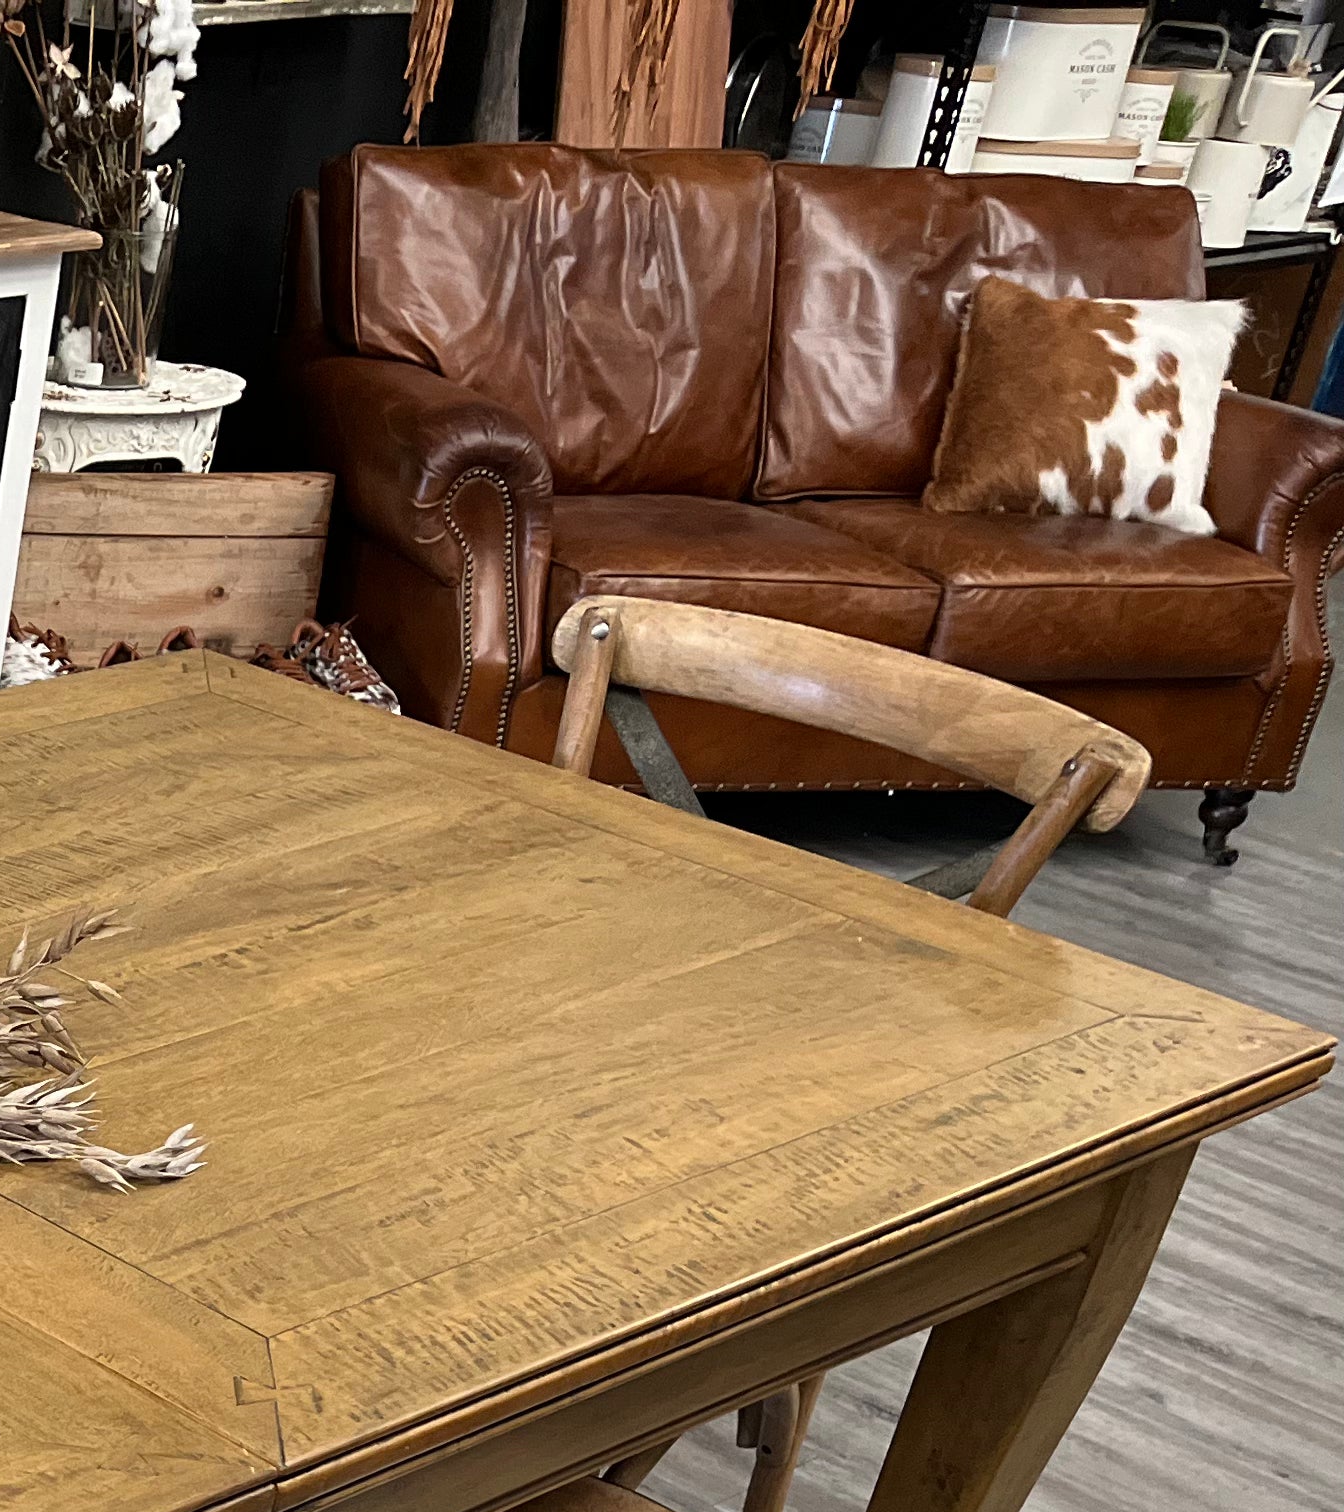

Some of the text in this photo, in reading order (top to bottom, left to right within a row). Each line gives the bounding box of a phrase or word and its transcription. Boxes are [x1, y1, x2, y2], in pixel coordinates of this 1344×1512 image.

[1069, 64, 1116, 74] MASON CASH
[1118, 112, 1148, 121] MASON
